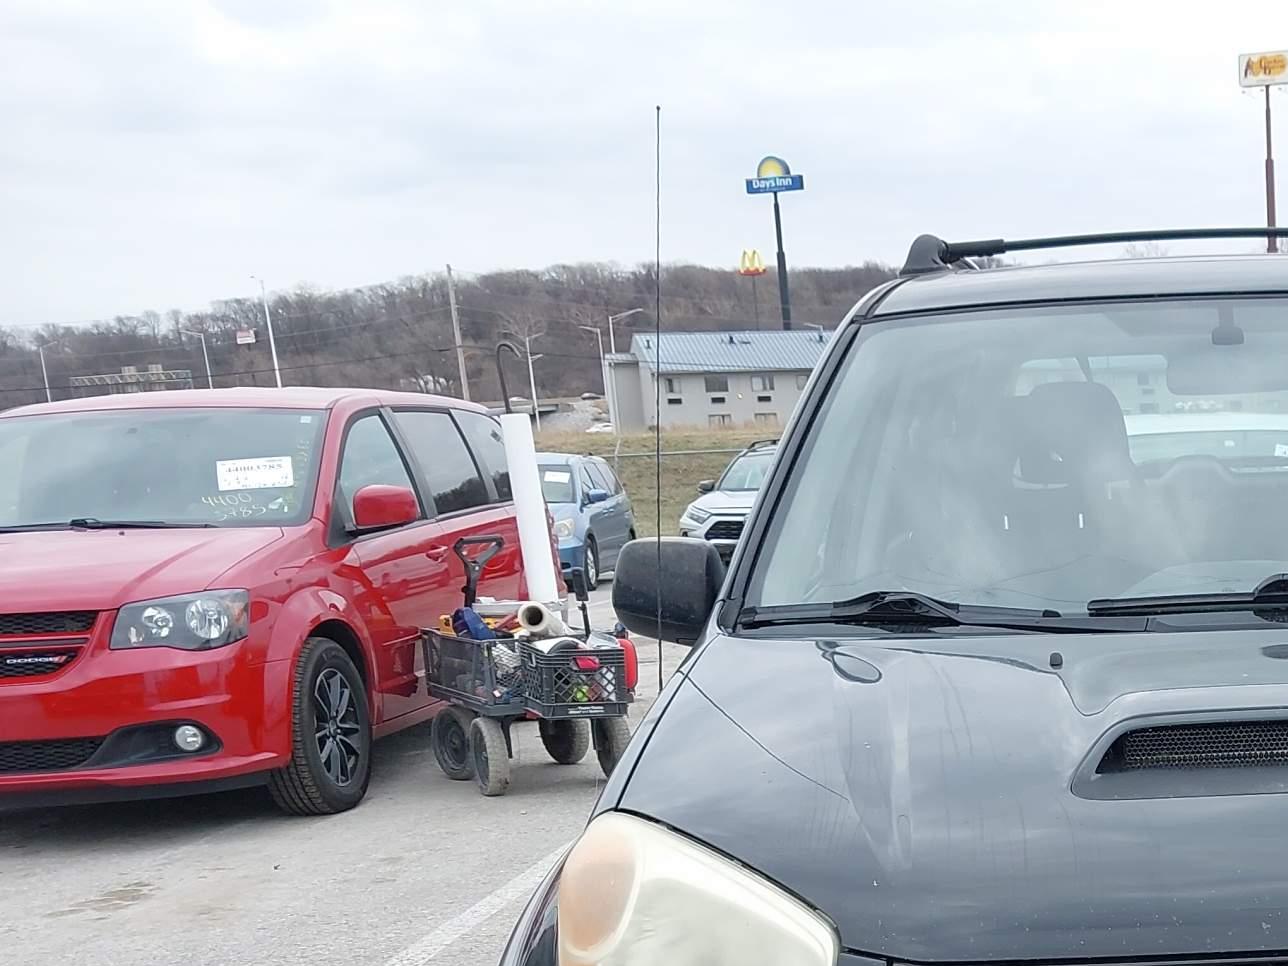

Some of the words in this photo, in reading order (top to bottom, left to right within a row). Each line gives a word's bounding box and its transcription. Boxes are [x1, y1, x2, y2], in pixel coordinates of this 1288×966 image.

[752, 178, 776, 189] Days
[776, 177, 793, 187] Inn
[201, 492, 252, 507] 4400
[6, 656, 57, 665] DODGE
